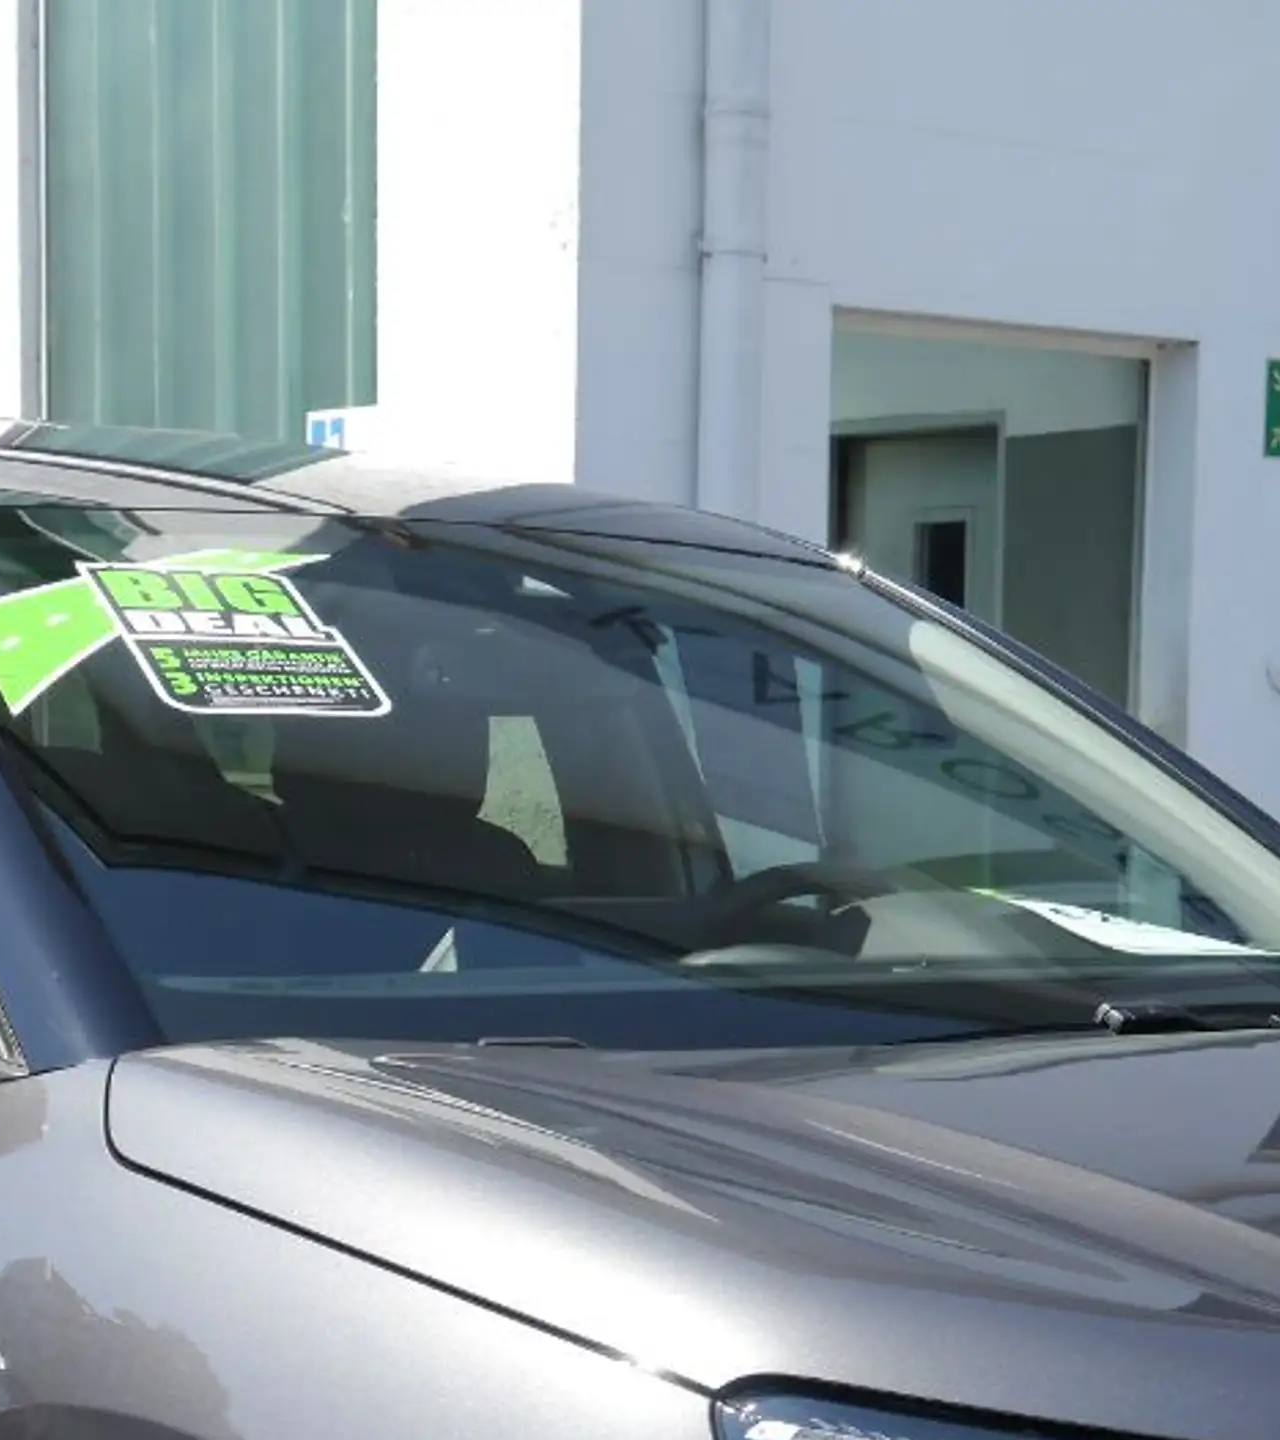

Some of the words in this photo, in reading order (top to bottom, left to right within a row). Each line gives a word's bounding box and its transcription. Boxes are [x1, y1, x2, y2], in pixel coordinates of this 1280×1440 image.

[96, 570, 302, 616] BIG
[122, 609, 326, 640] DEAL
[165, 671, 198, 695] 3
